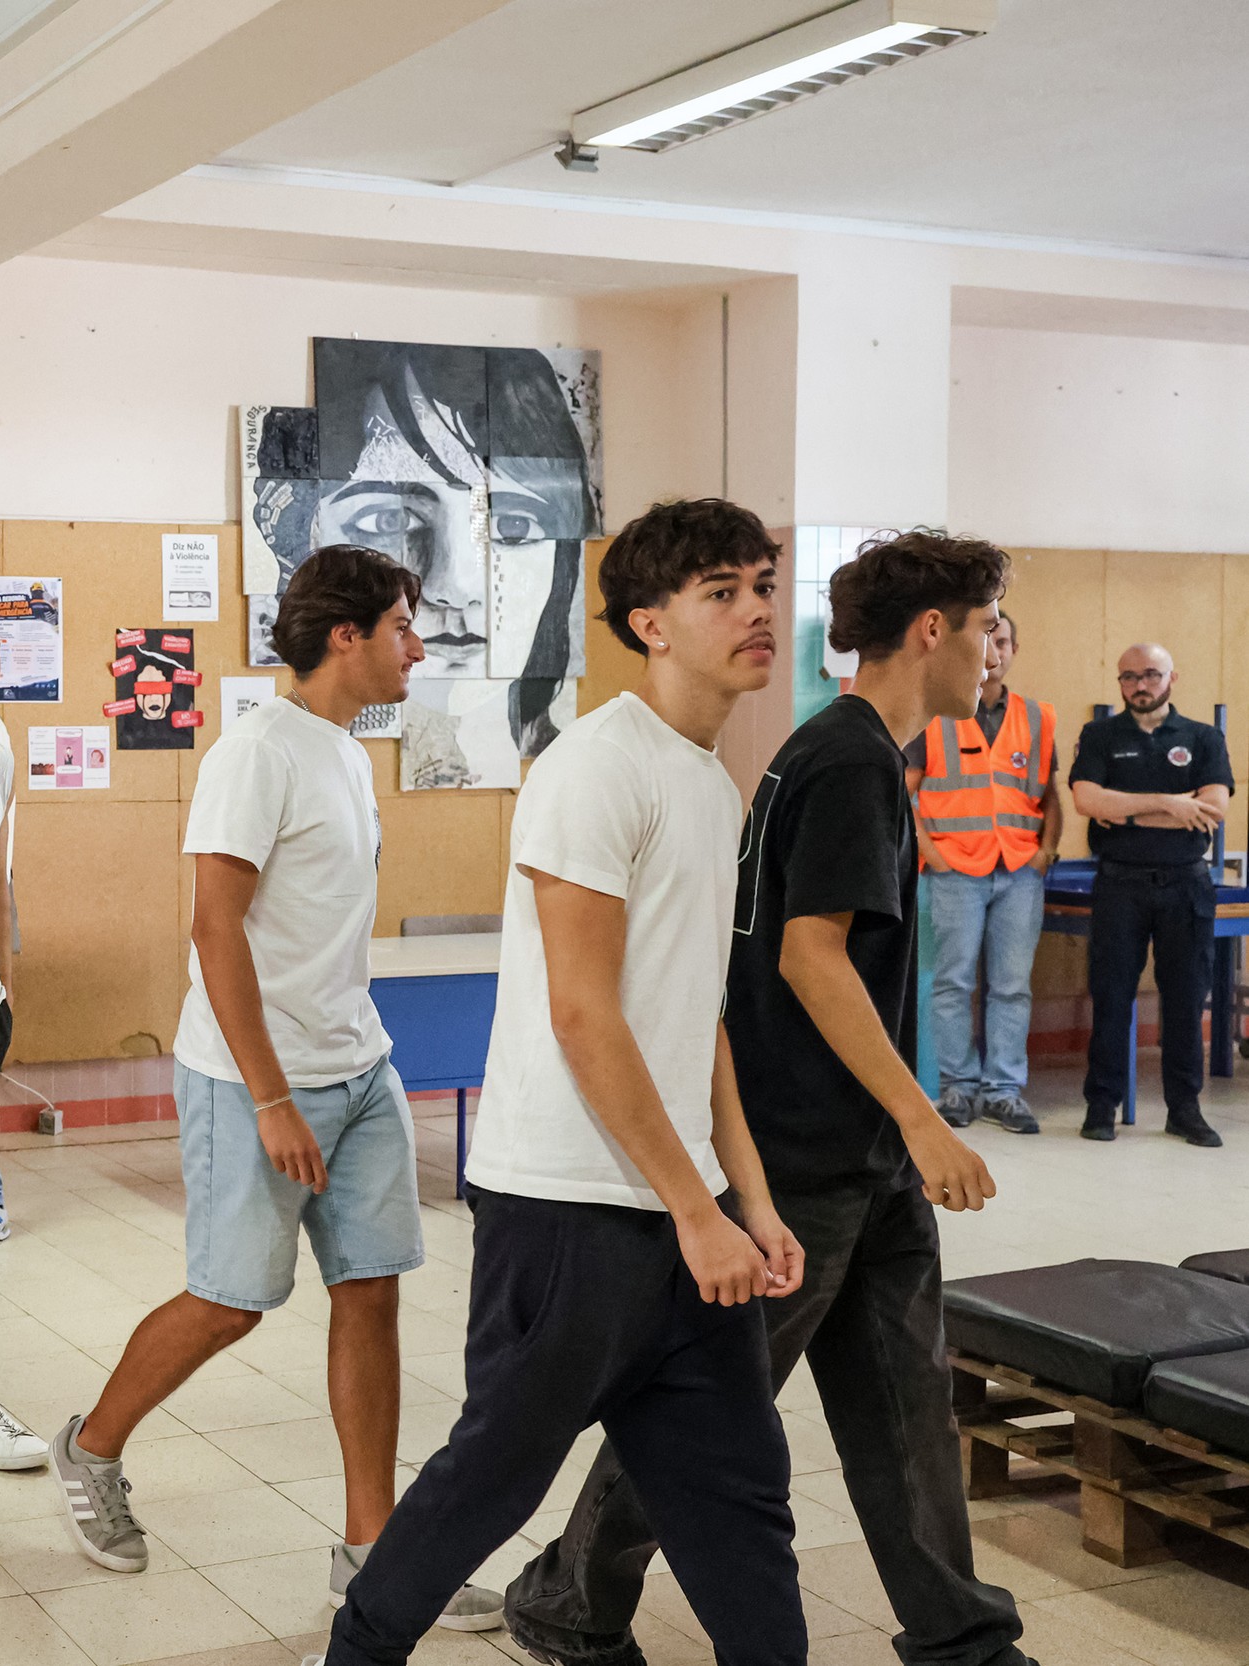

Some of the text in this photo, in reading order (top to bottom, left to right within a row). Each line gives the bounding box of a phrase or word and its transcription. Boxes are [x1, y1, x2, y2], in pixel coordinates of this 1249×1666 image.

[246, 404, 267, 469] SEGURANÇA
[172, 541, 205, 551] Diz NÃO
[169, 552, 210, 561] à Violência
